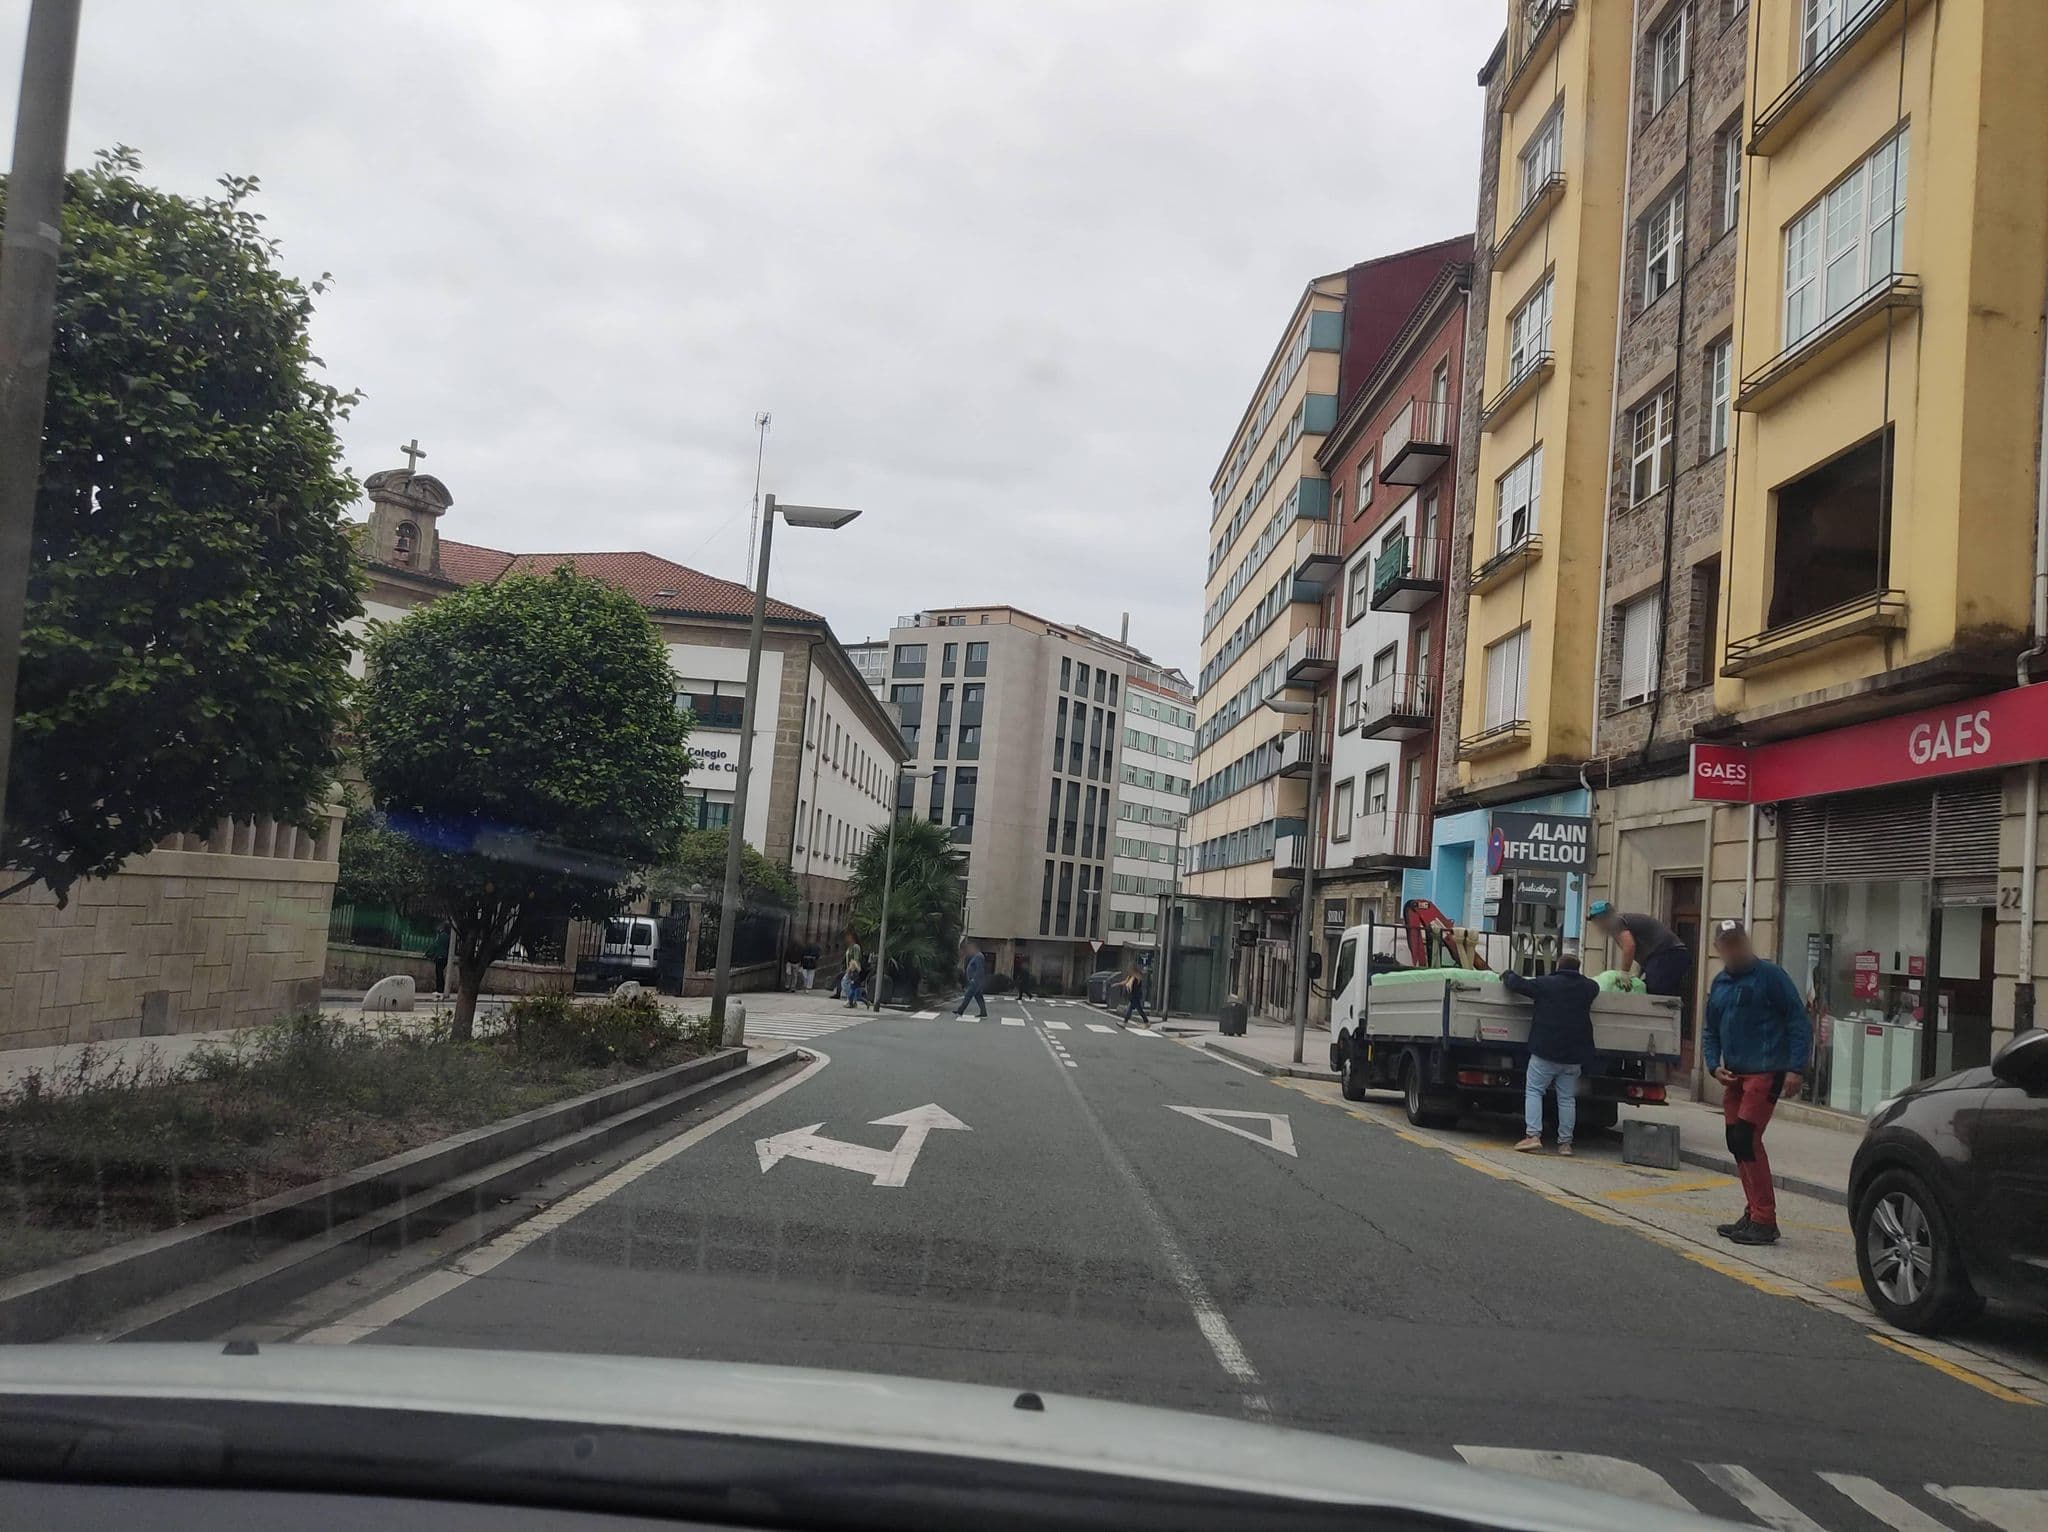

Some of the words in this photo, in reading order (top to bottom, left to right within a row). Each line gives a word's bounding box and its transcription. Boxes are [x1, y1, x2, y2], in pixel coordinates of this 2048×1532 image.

[1909, 710, 1991, 764] GAES
[687, 747, 727, 760] Colegio
[708, 762, 721, 771] de
[1697, 762, 1747, 779] GAES
[1528, 822, 1587, 843] ALAIN
[2001, 886, 2022, 909] 22
